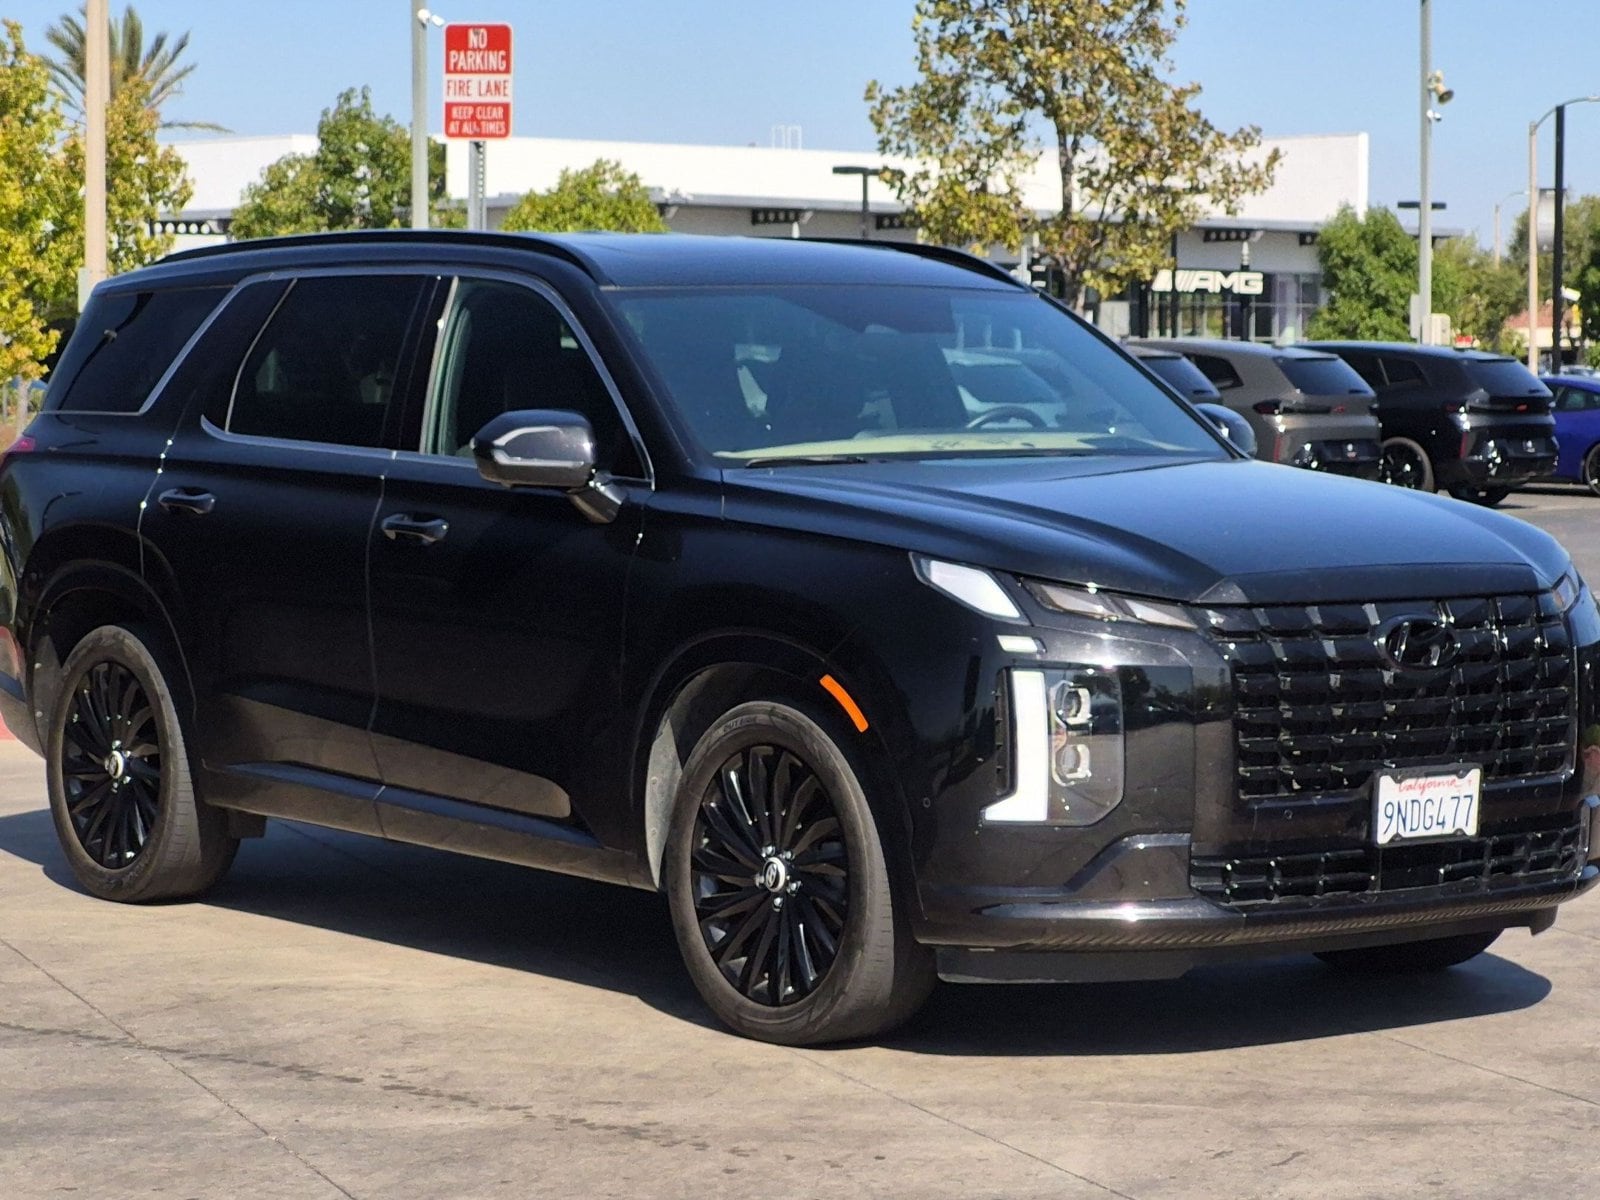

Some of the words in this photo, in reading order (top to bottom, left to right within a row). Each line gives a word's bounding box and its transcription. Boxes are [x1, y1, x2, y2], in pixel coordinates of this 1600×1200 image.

[468, 28, 488, 49] NO
[449, 50, 507, 71] PARKING
[447, 79, 472, 97] FIRE
[478, 79, 509, 97] LANE
[451, 106, 474, 120] KEEP
[475, 106, 504, 120] CLEAR
[448, 120, 460, 134] AT
[480, 120, 506, 135] TIMES
[1398, 776, 1459, 796] California
[1383, 794, 1474, 834] 9NDG477
